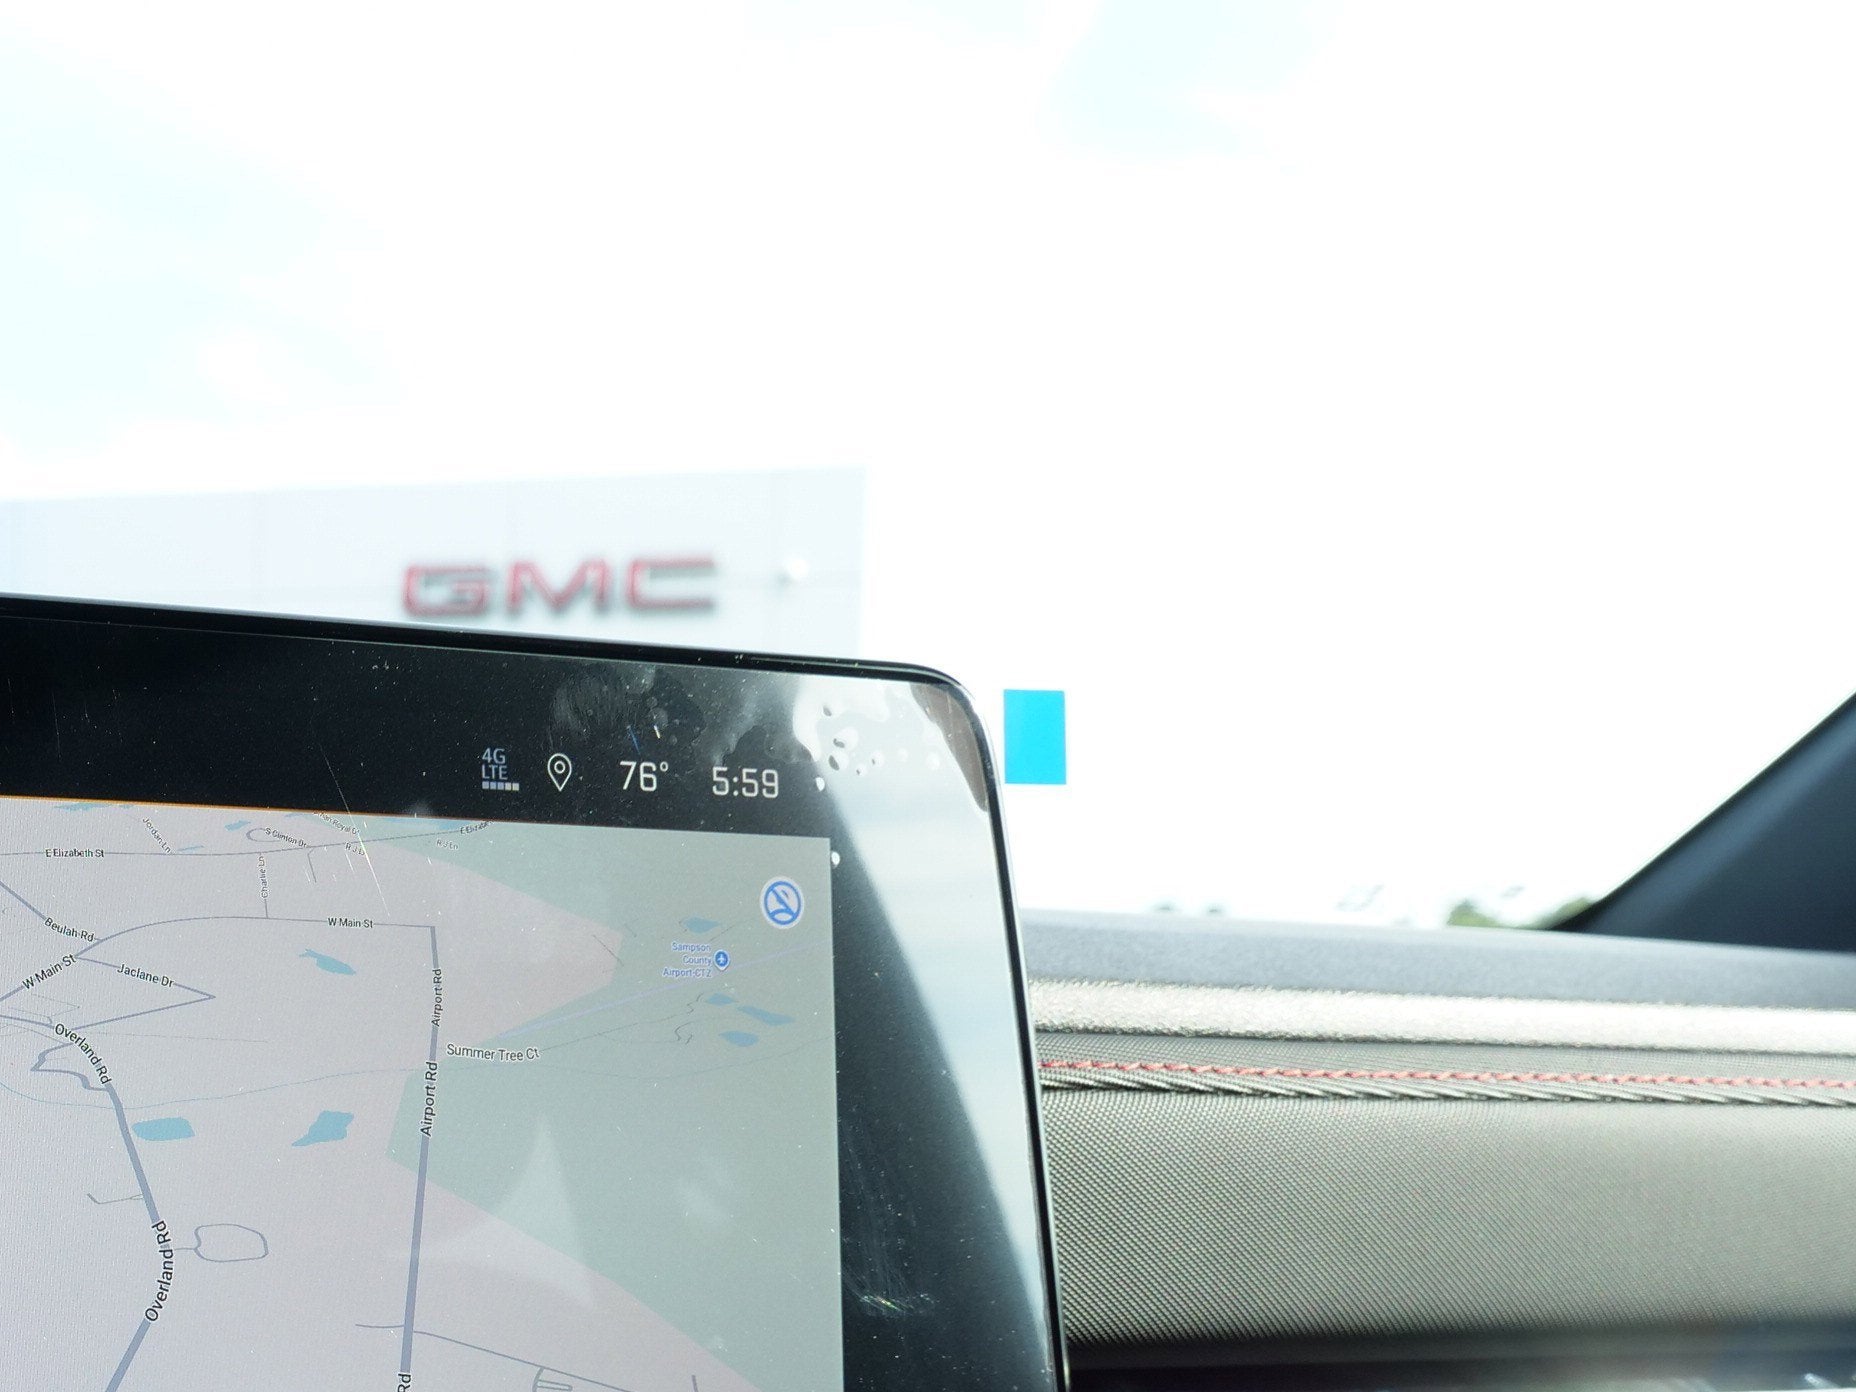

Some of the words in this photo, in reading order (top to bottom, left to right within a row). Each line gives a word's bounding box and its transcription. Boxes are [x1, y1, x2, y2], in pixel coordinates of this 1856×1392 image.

[401, 553, 717, 618] GMC
[482, 748, 506, 764] 4G
[482, 765, 508, 780] LTE
[619, 761, 669, 792] 76°
[712, 766, 779, 799] 5:59
[142, 817, 162, 844] Jordan
[53, 849, 94, 858] Elizabeth
[94, 849, 105, 858] St
[44, 917, 78, 938] Beulah
[80, 930, 95, 943] Rd
[327, 917, 338, 927] W
[339, 918, 362, 929] Main
[363, 919, 374, 929] St
[671, 942, 711, 953] Sampson
[682, 954, 712, 966] County
[22, 977, 36, 990] W
[34, 962, 63, 984] Main
[62, 953, 77, 968] St
[117, 963, 160, 984] Jaclane
[160, 975, 175, 988] Dr
[431, 968, 442, 984] Rd
[431, 986, 443, 1027] Airport
[54, 1023, 102, 1067] Overland
[95, 1064, 112, 1085] Rd
[446, 1043, 496, 1061] Summer
[498, 1049, 524, 1062] Tree
[424, 1061, 438, 1082] Rd
[420, 1084, 437, 1137] Airport
[151, 1220, 172, 1245] Rd
[144, 1248, 174, 1322] Overland
